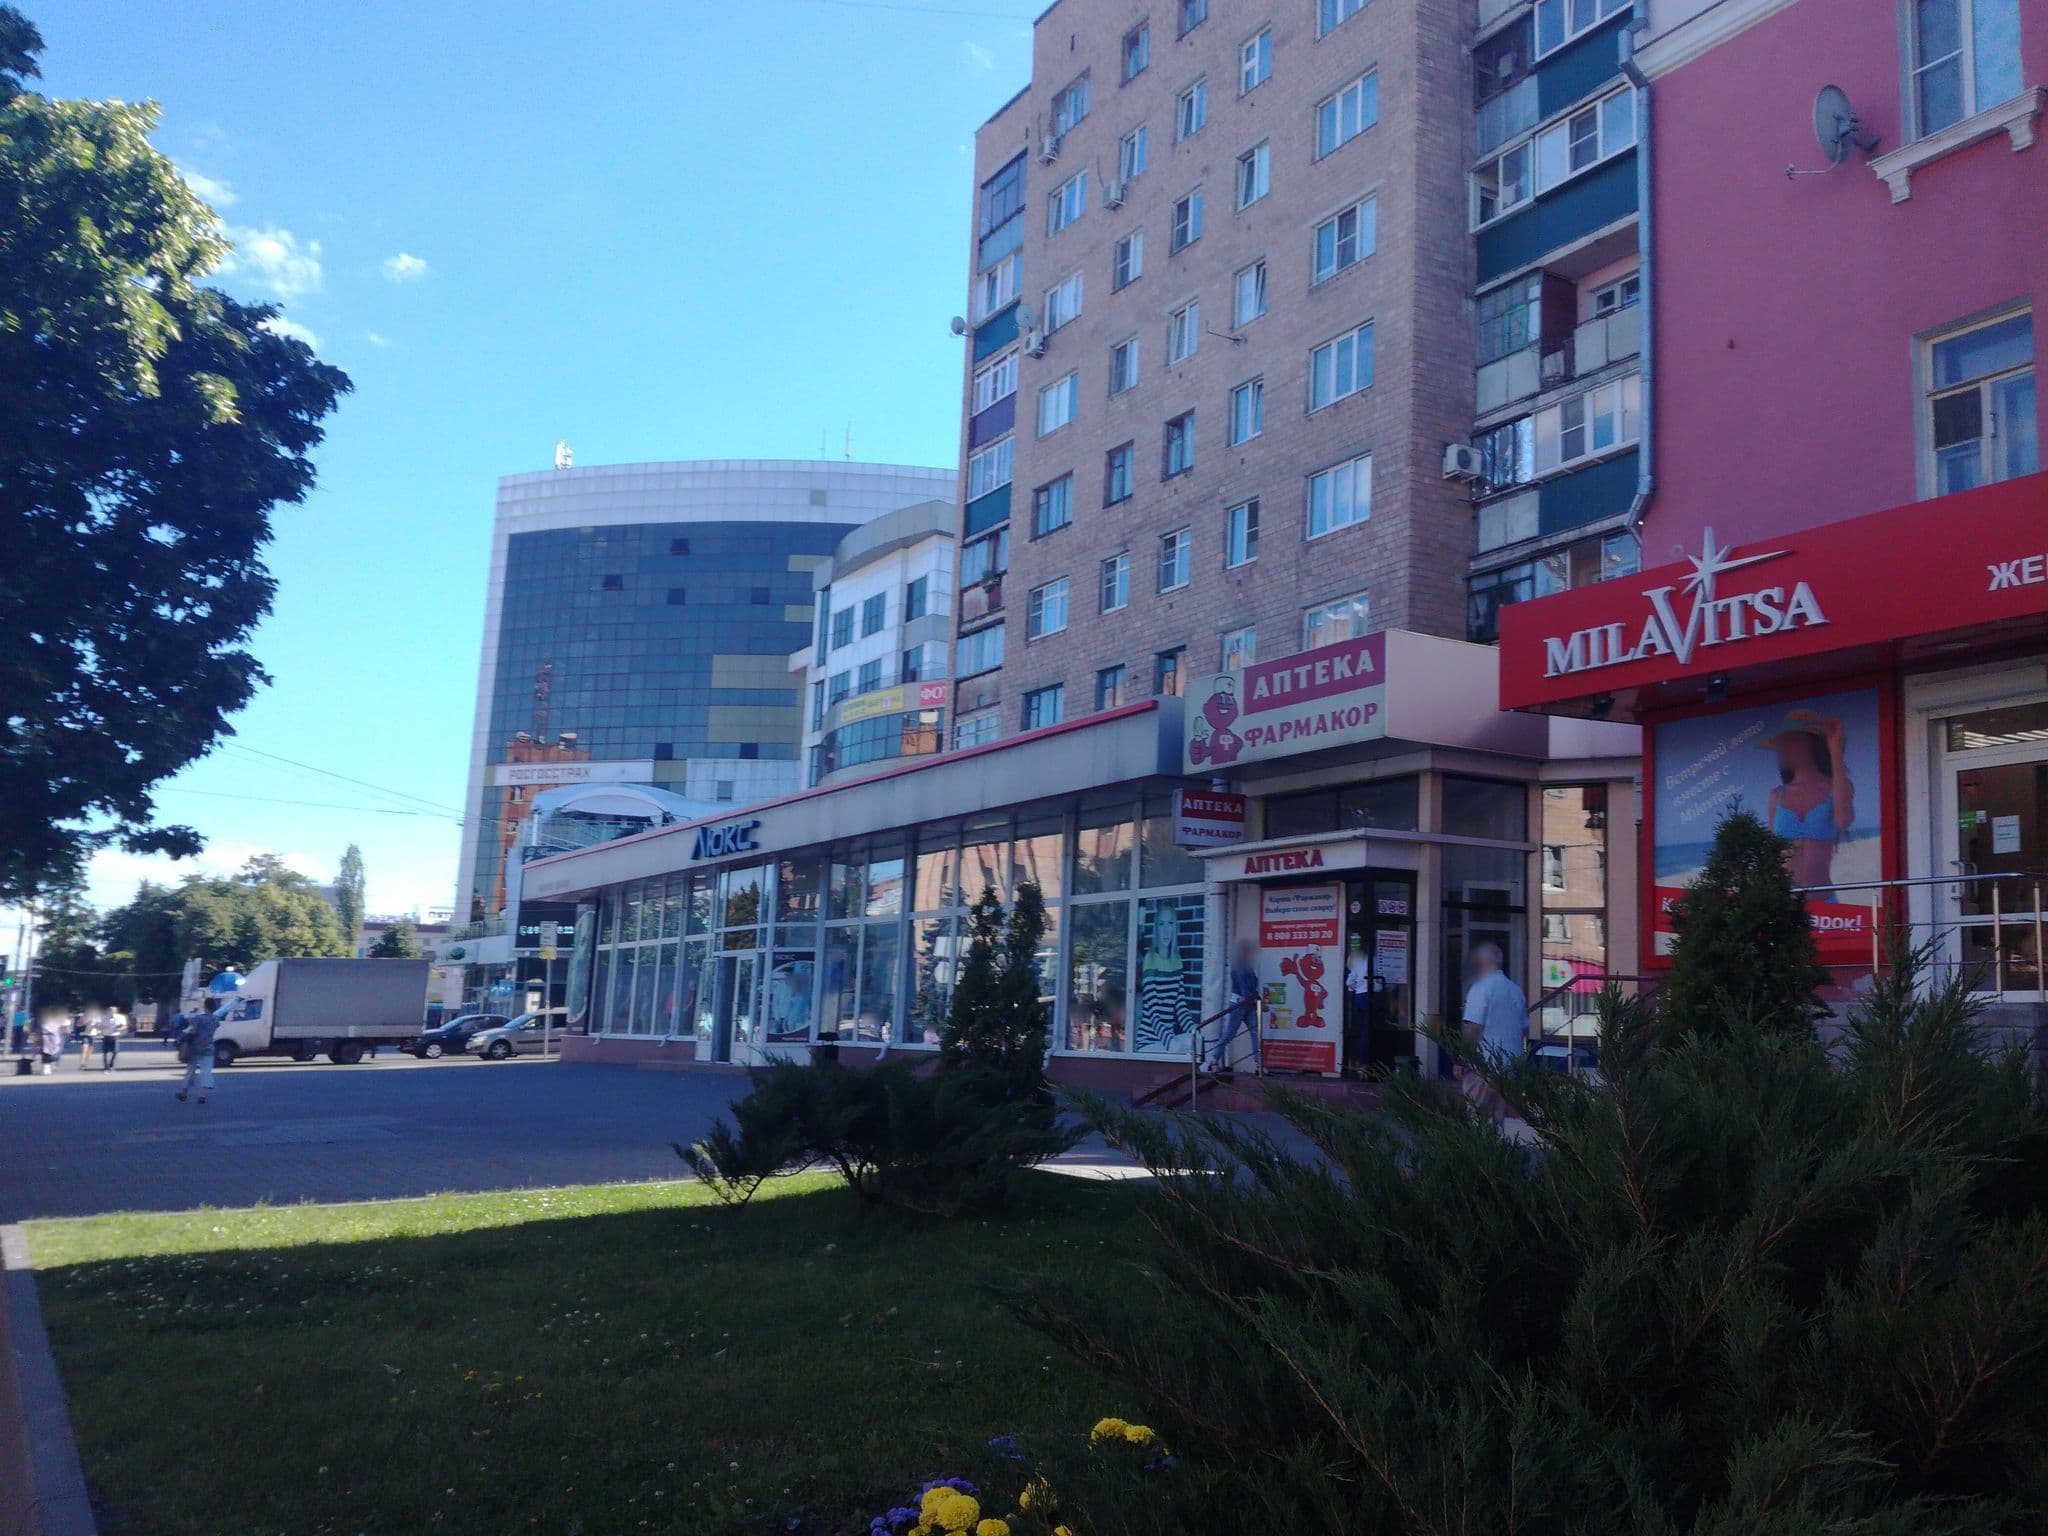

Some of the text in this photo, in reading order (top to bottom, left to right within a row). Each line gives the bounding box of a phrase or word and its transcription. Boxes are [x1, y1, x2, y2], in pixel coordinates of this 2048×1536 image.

[1987, 553, 2048, 591] ЖЕ
[1543, 580, 1829, 677] MILAVITSA
[1252, 648, 1375, 700] АПТЕКА
[1243, 702, 1378, 748] ФАРМАКОР
[1182, 797, 1243, 814] АПТЕКА
[691, 820, 761, 860] ЛЮКС
[1182, 826, 1242, 839] ФАРМАКОР
[1244, 849, 1323, 874] АПТЕКА
